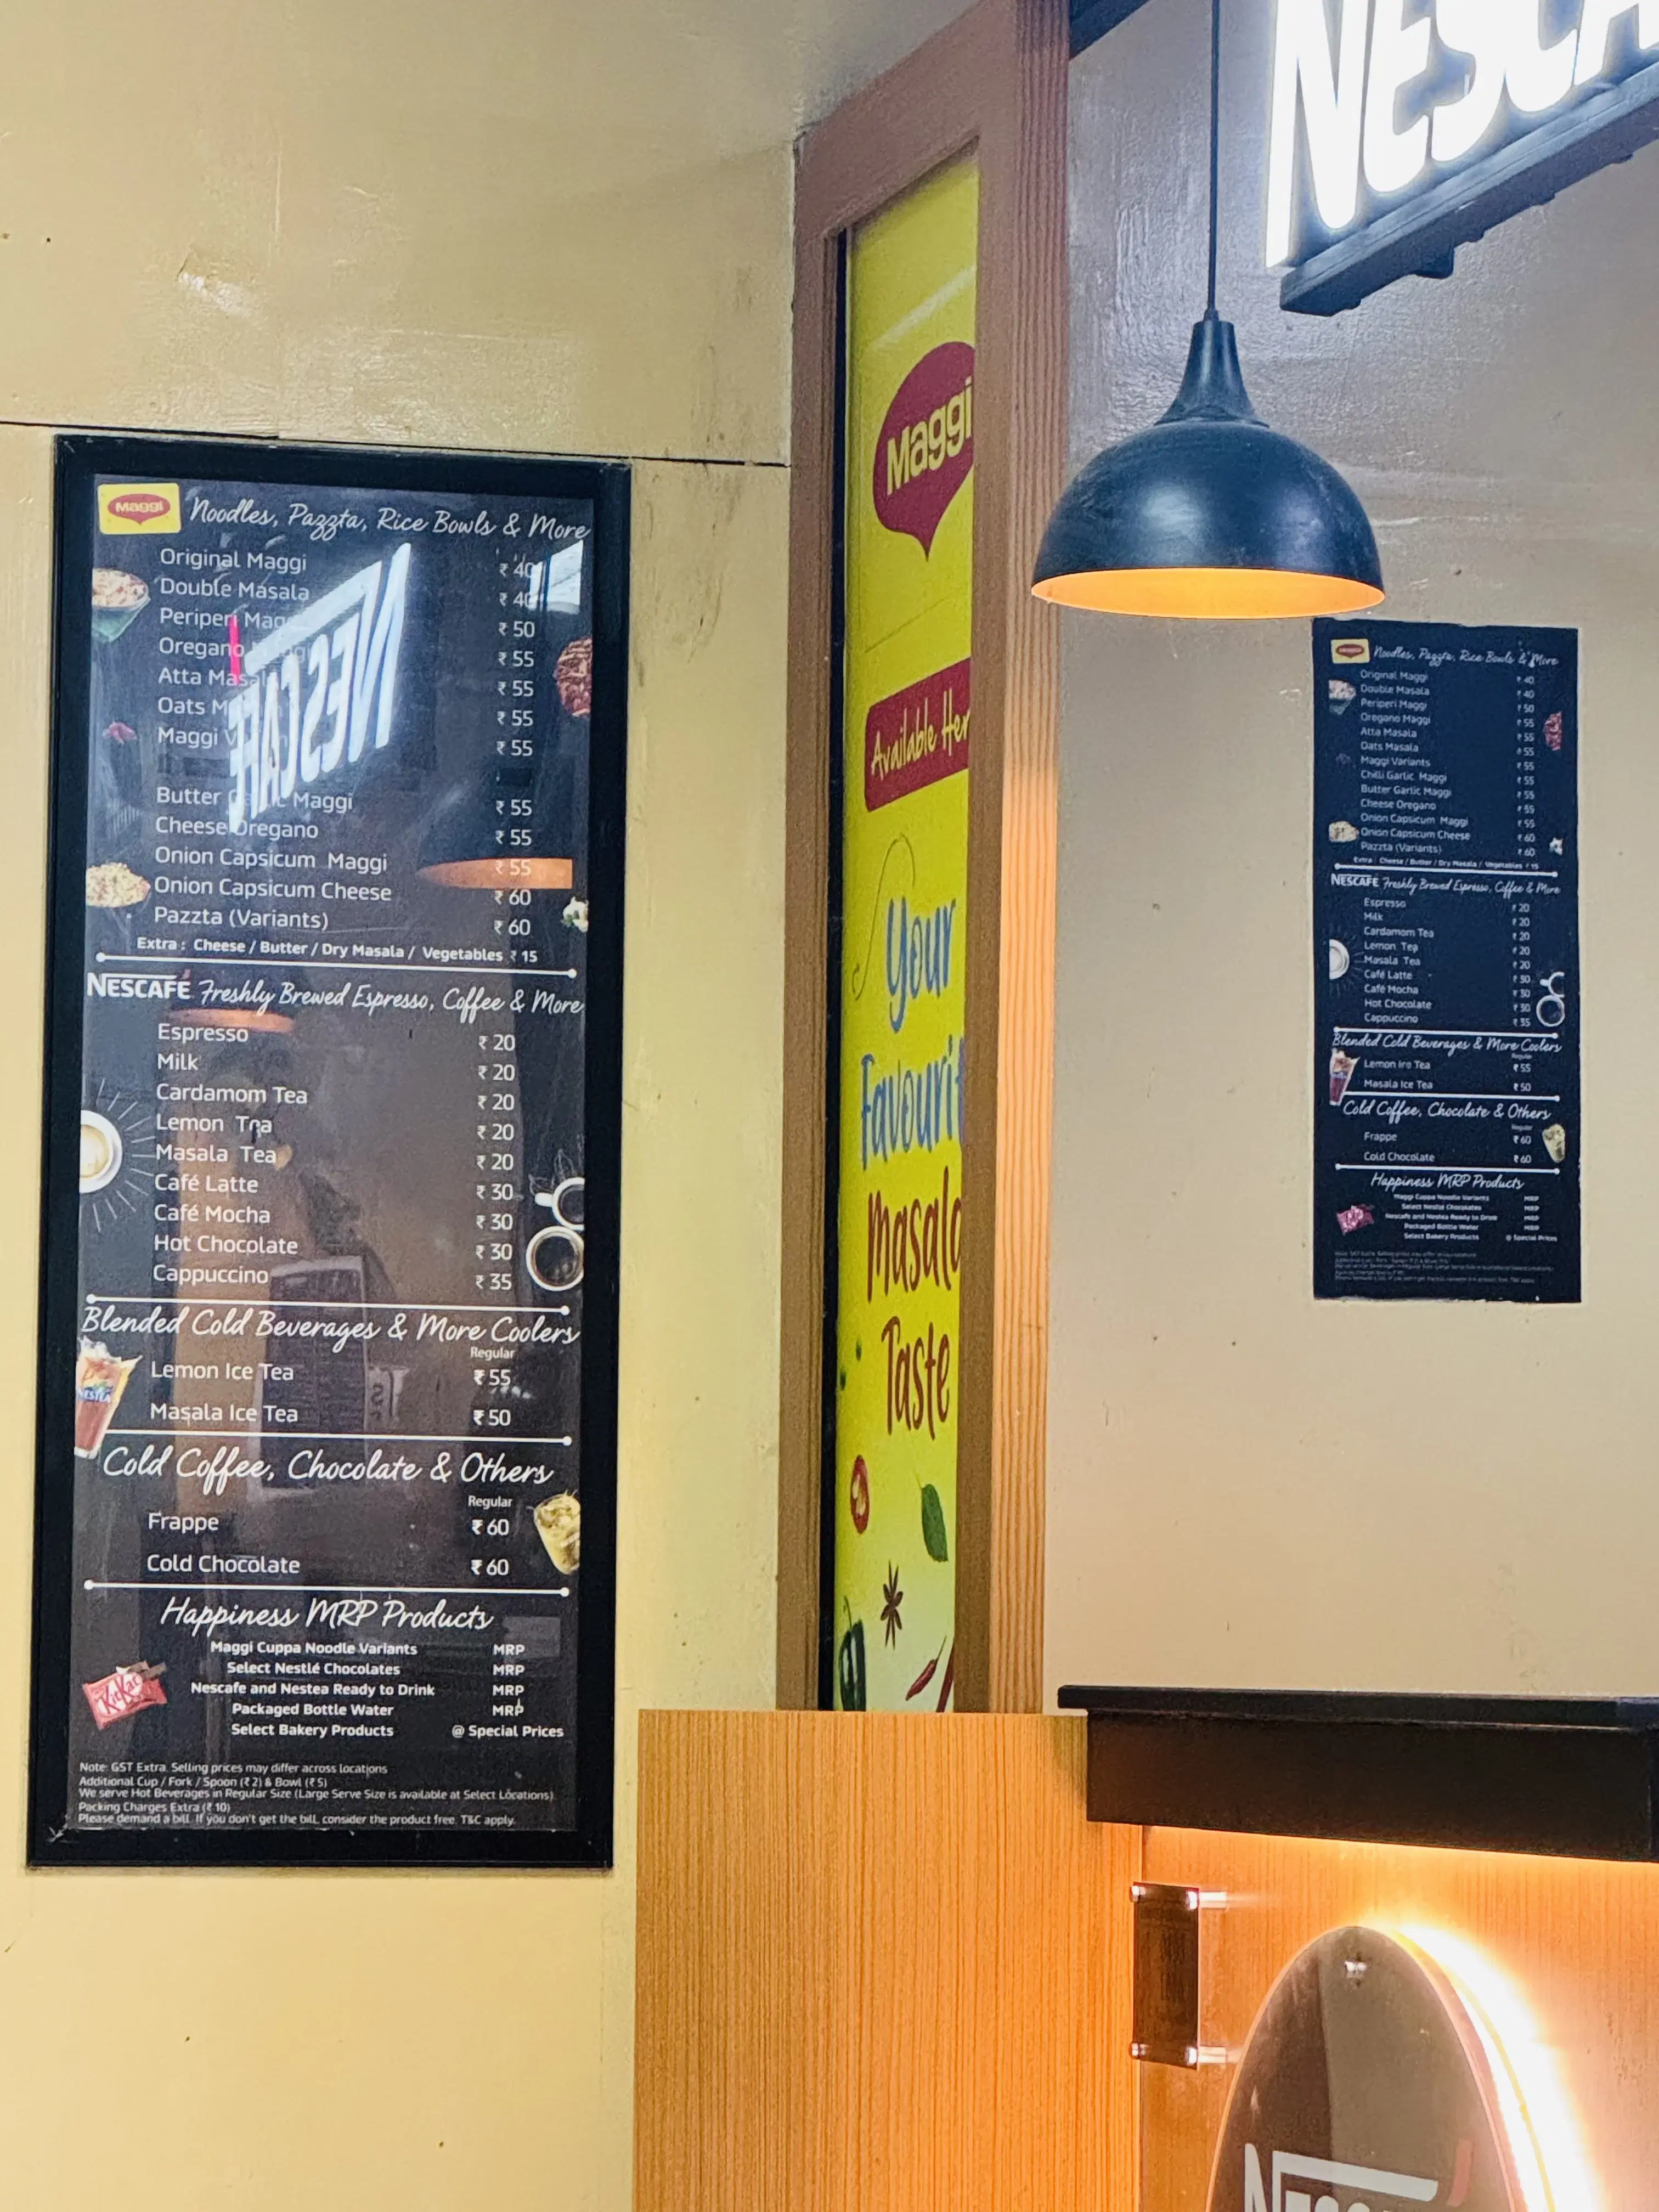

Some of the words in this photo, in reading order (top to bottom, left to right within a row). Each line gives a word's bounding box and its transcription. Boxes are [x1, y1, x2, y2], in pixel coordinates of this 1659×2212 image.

[887, 376, 973, 495] Maggi
[115, 501, 163, 513] Maggi
[190, 497, 278, 527] Noodles,
[289, 504, 366, 541] Pazzta,
[377, 508, 428, 531] Rice
[432, 511, 497, 535] Bowls
[503, 514, 520, 536] &
[529, 514, 591, 539] More
[161, 549, 239, 570] Original
[248, 550, 306, 574] Maggi
[161, 579, 231, 596] Double
[239, 581, 309, 600] Masala
[514, 621, 535, 638] 50
[160, 637, 244, 658] Oregano
[158, 668, 201, 685] Atta
[158, 697, 205, 715] Oats
[159, 727, 217, 749] Maggi
[871, 697, 937, 781] Available
[1361, 742, 1383, 752] Oats
[1385, 743, 1419, 753] Masala
[157, 787, 222, 805] Butter
[294, 793, 353, 814] Maggi
[156, 816, 228, 836] Cheese
[235, 821, 318, 840] Oregano
[155, 847, 213, 865] Onion
[219, 849, 315, 870] Capsicum
[328, 853, 387, 875] Maggi
[155, 876, 212, 894] Onion
[219, 879, 315, 899] Capsicum
[321, 882, 391, 901] Cheese
[155, 907, 222, 924] Pazzta
[229, 910, 328, 930] (Variants)
[885, 896, 956, 1034] Your
[198, 979, 276, 1016] Freshly
[279, 981, 352, 1006] Brewed
[352, 984, 434, 1015] Espresso,
[443, 987, 505, 1024] Coffee
[510, 989, 525, 1012] &
[531, 989, 584, 1015] More
[1364, 999, 1382, 1008] Hot
[1385, 1000, 1432, 1010] Chocolate
[1364, 1013, 1419, 1024] Cappuccino
[158, 1023, 249, 1042] Espresso
[493, 1034, 515, 1051] 20
[1332, 1033, 1378, 1047] Blended
[1383, 1034, 1413, 1048] Cold
[1412, 1035, 1470, 1056] Beverages
[1473, 1036, 1483, 1049] &
[1486, 1037, 1519, 1051] More
[1521, 1039, 1562, 1053] Coolers
[158, 1054, 198, 1070] Milk
[157, 1084, 266, 1102] Cardamom
[273, 1087, 307, 1103] Tea
[1343, 1099, 1376, 1115] Cold
[1376, 1101, 1422, 1124] Coffee,
[1428, 1102, 1491, 1118] Chocolate
[1493, 1103, 1505, 1118] &
[1508, 1103, 1551, 1120] Others
[157, 1114, 224, 1132] Lemon
[1364, 1132, 1398, 1142] Frappe
[156, 1144, 228, 1161] Masala
[240, 1146, 276, 1163] Tea
[1364, 1152, 1385, 1161] Cold
[1387, 1152, 1435, 1163] Chocolate
[155, 1173, 199, 1191] Café
[206, 1176, 258, 1193] Latte
[1371, 1172, 1435, 1192] Happiness
[1437, 1174, 1472, 1189] MRP
[1473, 1174, 1525, 1190] Products
[155, 1204, 198, 1221] Café
[205, 1206, 270, 1223] Mocha
[155, 1235, 191, 1252] Hot
[198, 1235, 298, 1254] Chocolate
[154, 1265, 269, 1285] Cappuccino
[490, 1273, 512, 1290] 35
[82, 1305, 190, 1333] Blended
[192, 1308, 255, 1335] Cold
[255, 1311, 381, 1353] Beverages
[388, 1313, 407, 1341] &
[416, 1313, 486, 1342] More
[491, 1316, 580, 1343] Coolers
[470, 1347, 515, 1362] Regular
[151, 1361, 218, 1379] Lemon
[226, 1363, 252, 1380] Ice
[259, 1364, 294, 1380] Tea
[881, 1316, 950, 1442] Taste
[150, 1403, 221, 1421] Masala
[230, 1404, 257, 1421] Ice
[263, 1406, 298, 1422] Tea
[103, 1444, 173, 1476] Cold
[176, 1446, 274, 1496] Coffee,
[288, 1449, 422, 1481] Chocolate
[430, 1452, 452, 1483] &
[461, 1452, 554, 1484] Others
[468, 1495, 513, 1510] Regular
[149, 1513, 219, 1534] Frappe
[147, 1554, 193, 1572] Cold
[199, 1555, 300, 1574] Chocolate
[161, 1596, 300, 1637] Happiness
[306, 1598, 377, 1629] MRP
[382, 1599, 494, 1629] Products
[211, 1641, 253, 1656] Maggi
[257, 1641, 301, 1656] Cuppa
[305, 1642, 355, 1655] Noodle
[359, 1644, 417, 1655] Variants
[494, 1644, 525, 1656] MRP
[227, 1662, 272, 1674] Select
[275, 1662, 320, 1675] Nestlé
[324, 1663, 400, 1675] Chocolates
[493, 1664, 524, 1676] MRP
[191, 1682, 246, 1694] Nescafe
[251, 1683, 276, 1695] and
[281, 1683, 329, 1695] Nestea
[334, 1684, 376, 1698] Ready
[380, 1685, 394, 1696] to
[398, 1684, 435, 1696] Drink
[493, 1685, 524, 1696] MRP
[232, 1703, 299, 1718] Packaged
[303, 1704, 347, 1716] Bottle
[351, 1705, 394, 1717] Water
[493, 1705, 524, 1717] MRP
[232, 1724, 275, 1736] Select
[279, 1724, 328, 1739] Bakery
[331, 1724, 393, 1736] Products
[452, 1725, 465, 1739] @
[469, 1725, 518, 1739] Special
[522, 1725, 564, 1738] Prices
[79, 1788, 96, 1798] We
[99, 1790, 128, 1798] serve
[131, 1789, 150, 1798] Hot
[154, 1789, 210, 1800] Beverages
[225, 1790, 267, 1800] Regular
[270, 1790, 291, 1799] Size
[331, 1791, 361, 1799] Serve
[364, 1791, 385, 1799] Size
[399, 1791, 447, 1800] available
[463, 1791, 495, 1800] Select
